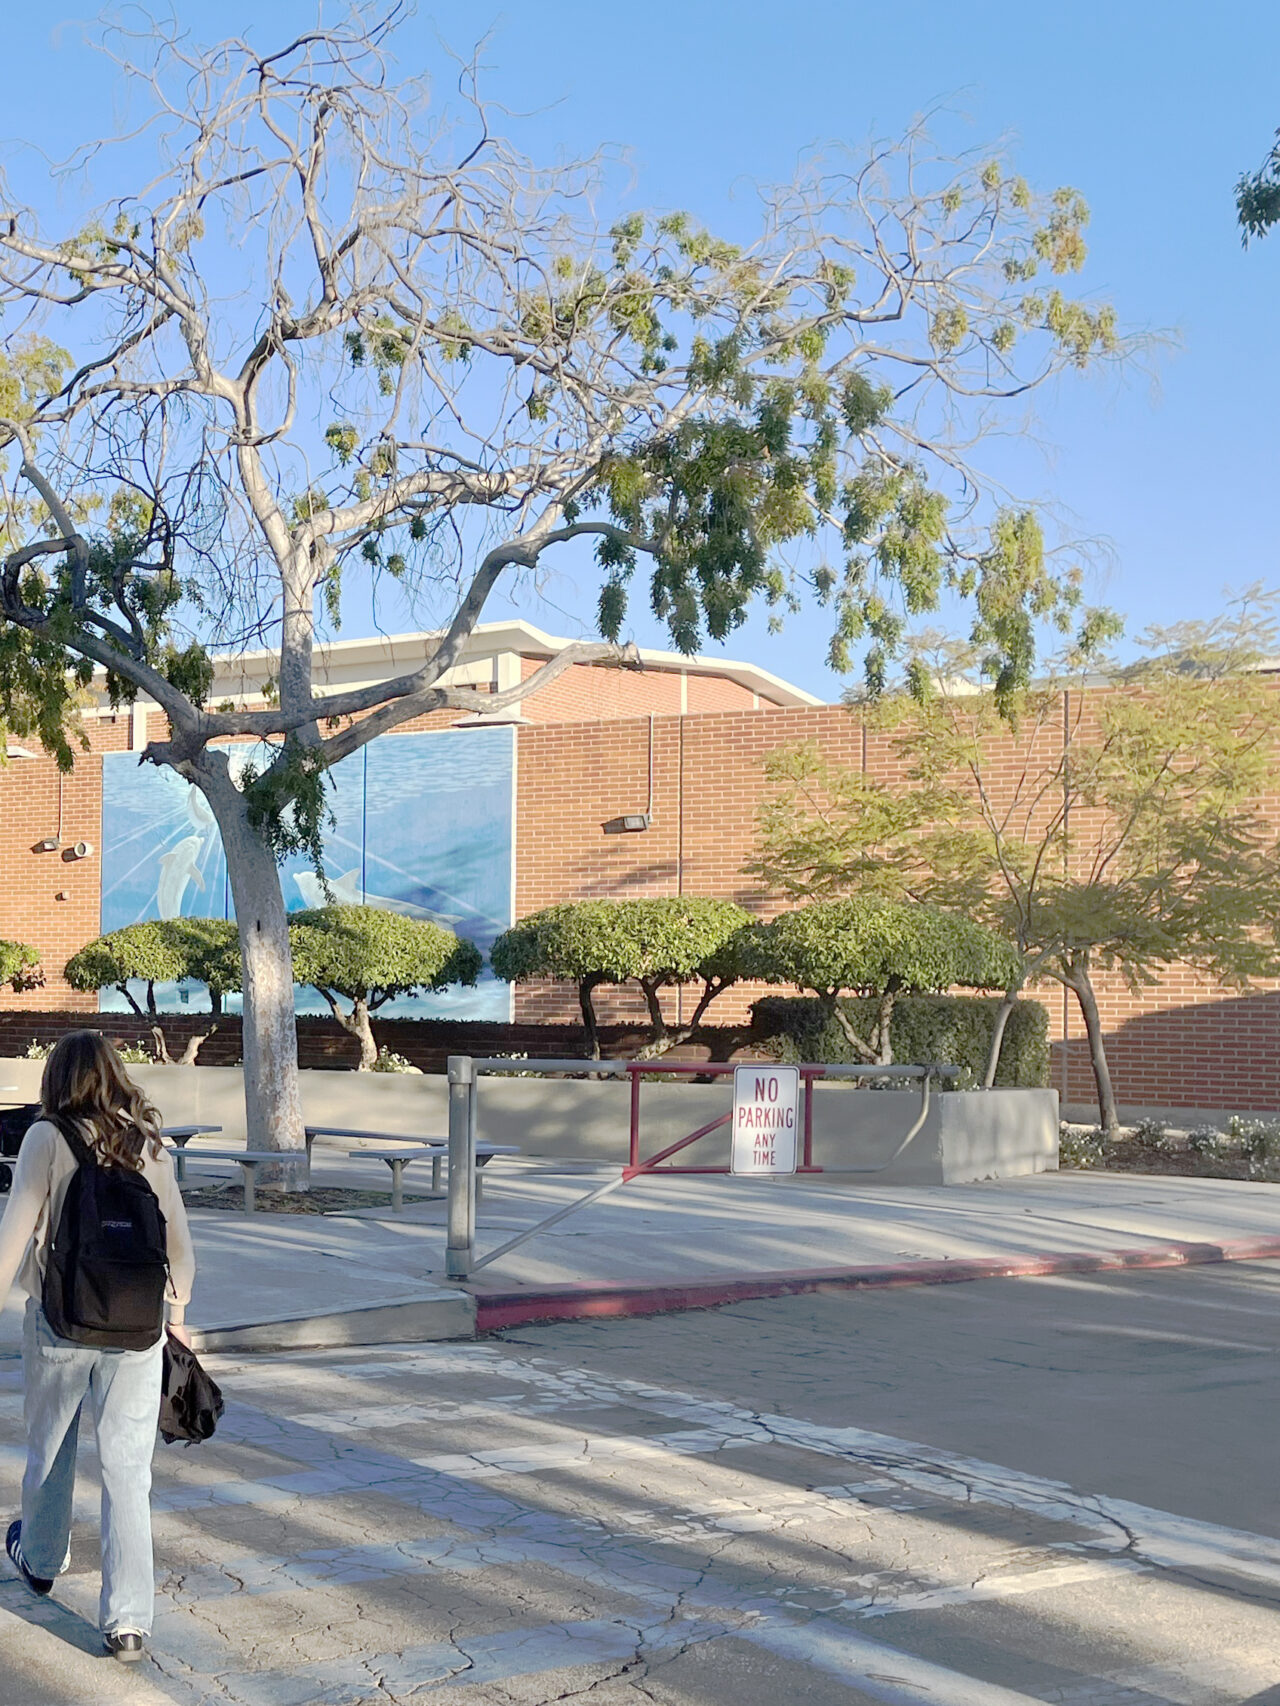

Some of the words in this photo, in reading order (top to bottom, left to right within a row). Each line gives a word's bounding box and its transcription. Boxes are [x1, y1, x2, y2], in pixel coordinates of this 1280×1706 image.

[755, 1077, 778, 1102] NO
[738, 1106, 793, 1129] PARKING
[754, 1133, 776, 1149] ANY
[753, 1150, 776, 1166] TIME
